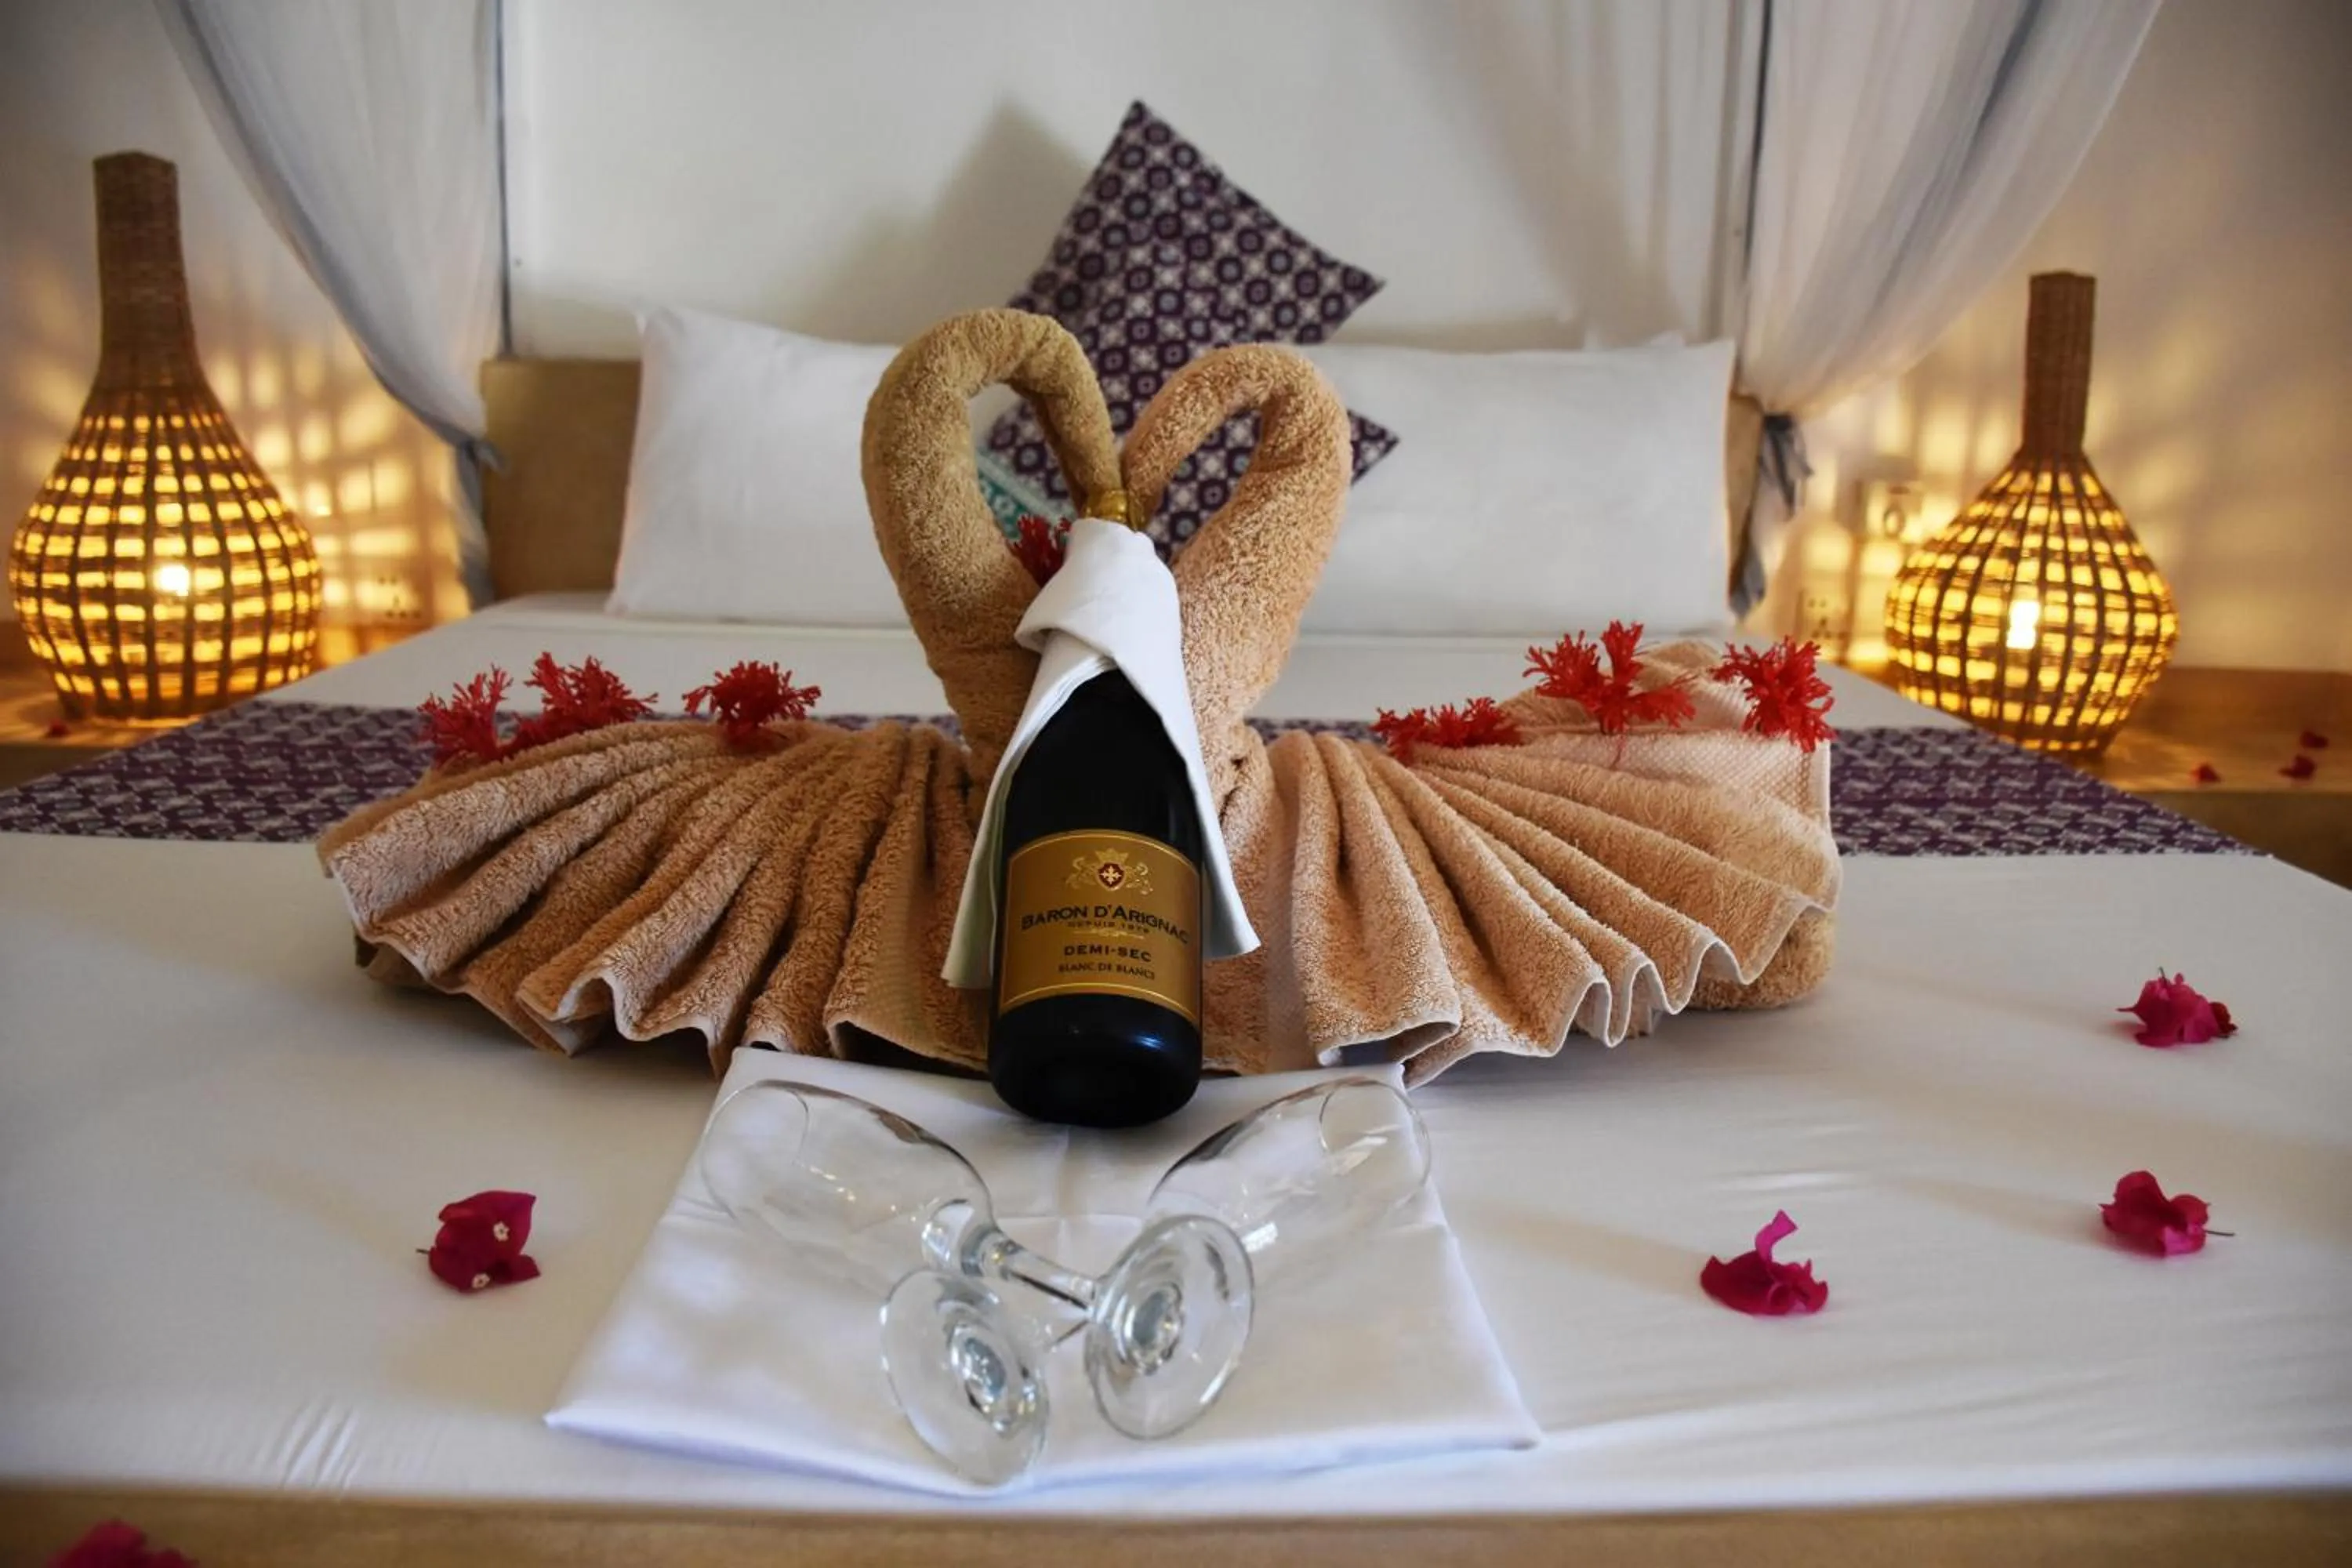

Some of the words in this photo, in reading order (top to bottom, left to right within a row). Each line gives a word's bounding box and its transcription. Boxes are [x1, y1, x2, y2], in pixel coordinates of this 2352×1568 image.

[1021, 906, 1087, 931] BARON
[1094, 904, 1191, 944] D'ARIGNAC
[1064, 944, 1152, 963] DEMI-SEC
[1058, 962, 1096, 974] BLANC
[1098, 963, 1112, 973] DE
